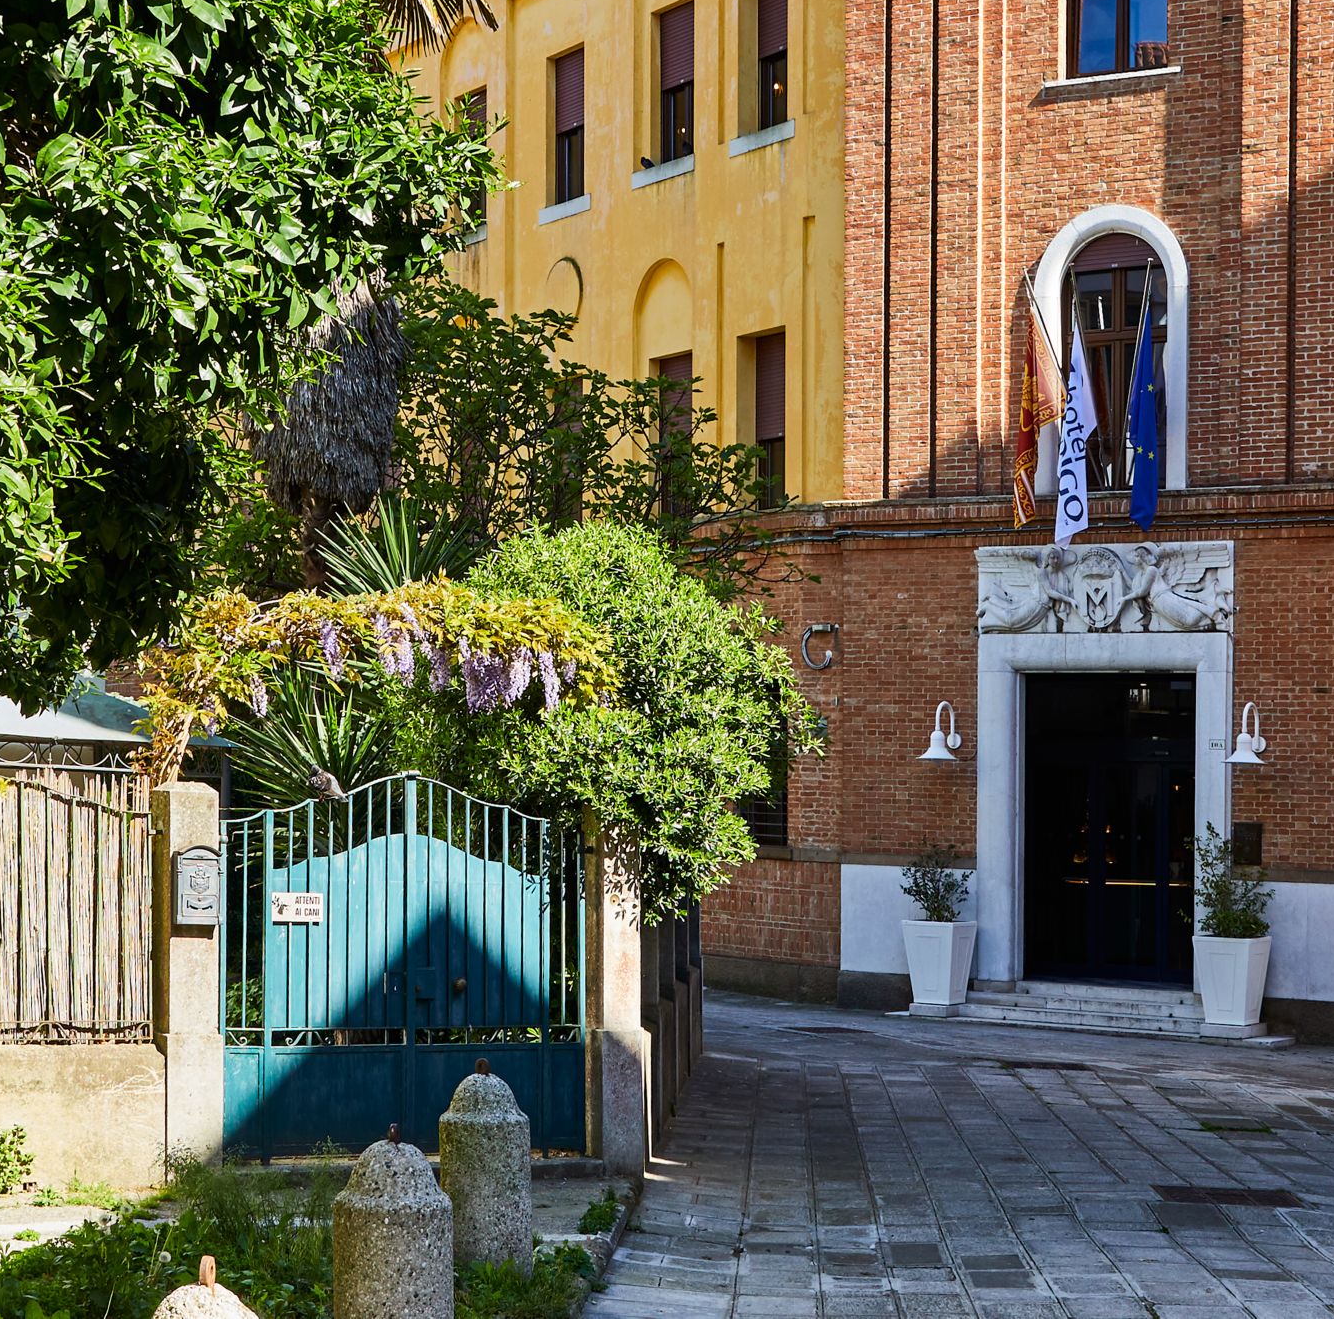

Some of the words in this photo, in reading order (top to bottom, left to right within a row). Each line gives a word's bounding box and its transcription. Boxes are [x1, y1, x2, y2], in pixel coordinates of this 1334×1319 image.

[295, 896, 320, 905] ATTENTI
[295, 908, 302, 916] AI
[304, 908, 320, 916] CANI
